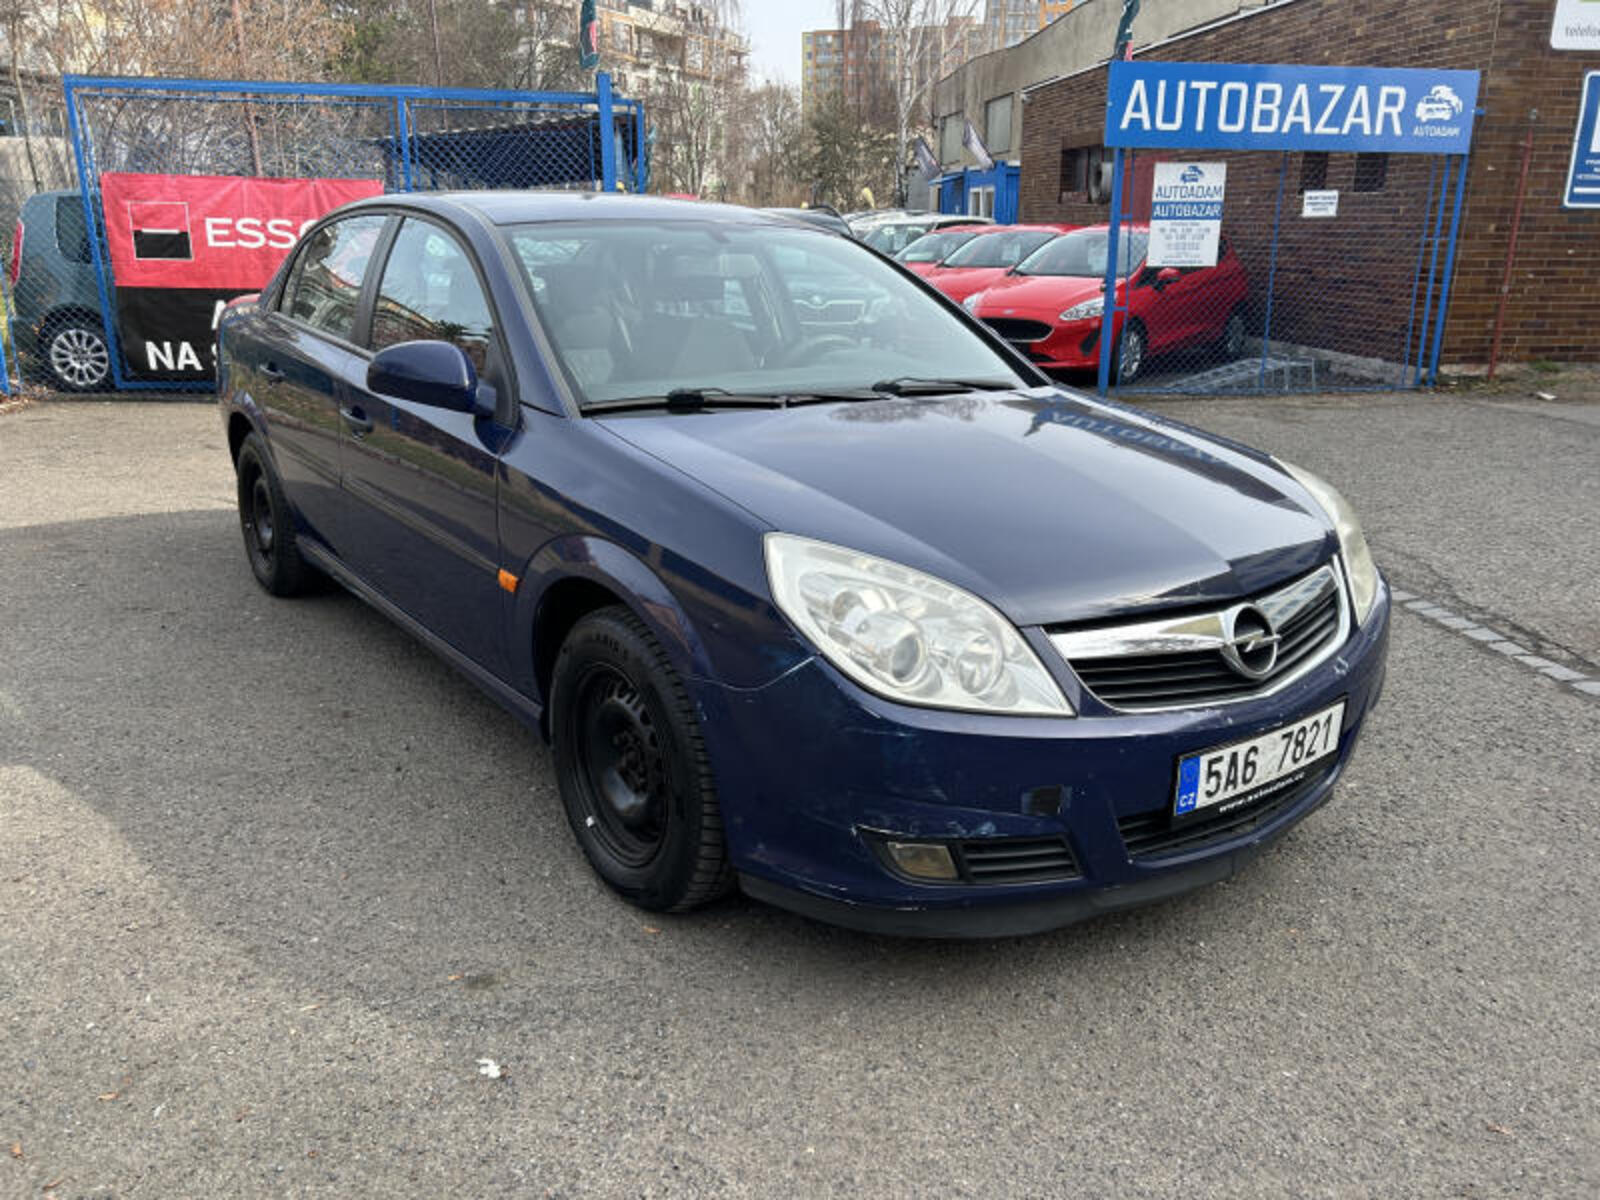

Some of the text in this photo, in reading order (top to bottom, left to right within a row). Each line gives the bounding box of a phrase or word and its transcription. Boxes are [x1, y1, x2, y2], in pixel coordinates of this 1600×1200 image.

[1120, 79, 1407, 135] AUTOBAZAR
[1155, 185, 1222, 199] AUTOADAM
[1153, 203, 1221, 217] AUTOBAZAR
[145, 341, 203, 371] NA
[1205, 711, 1333, 799] 5A6 7821
[1179, 792, 1195, 807] CZ
